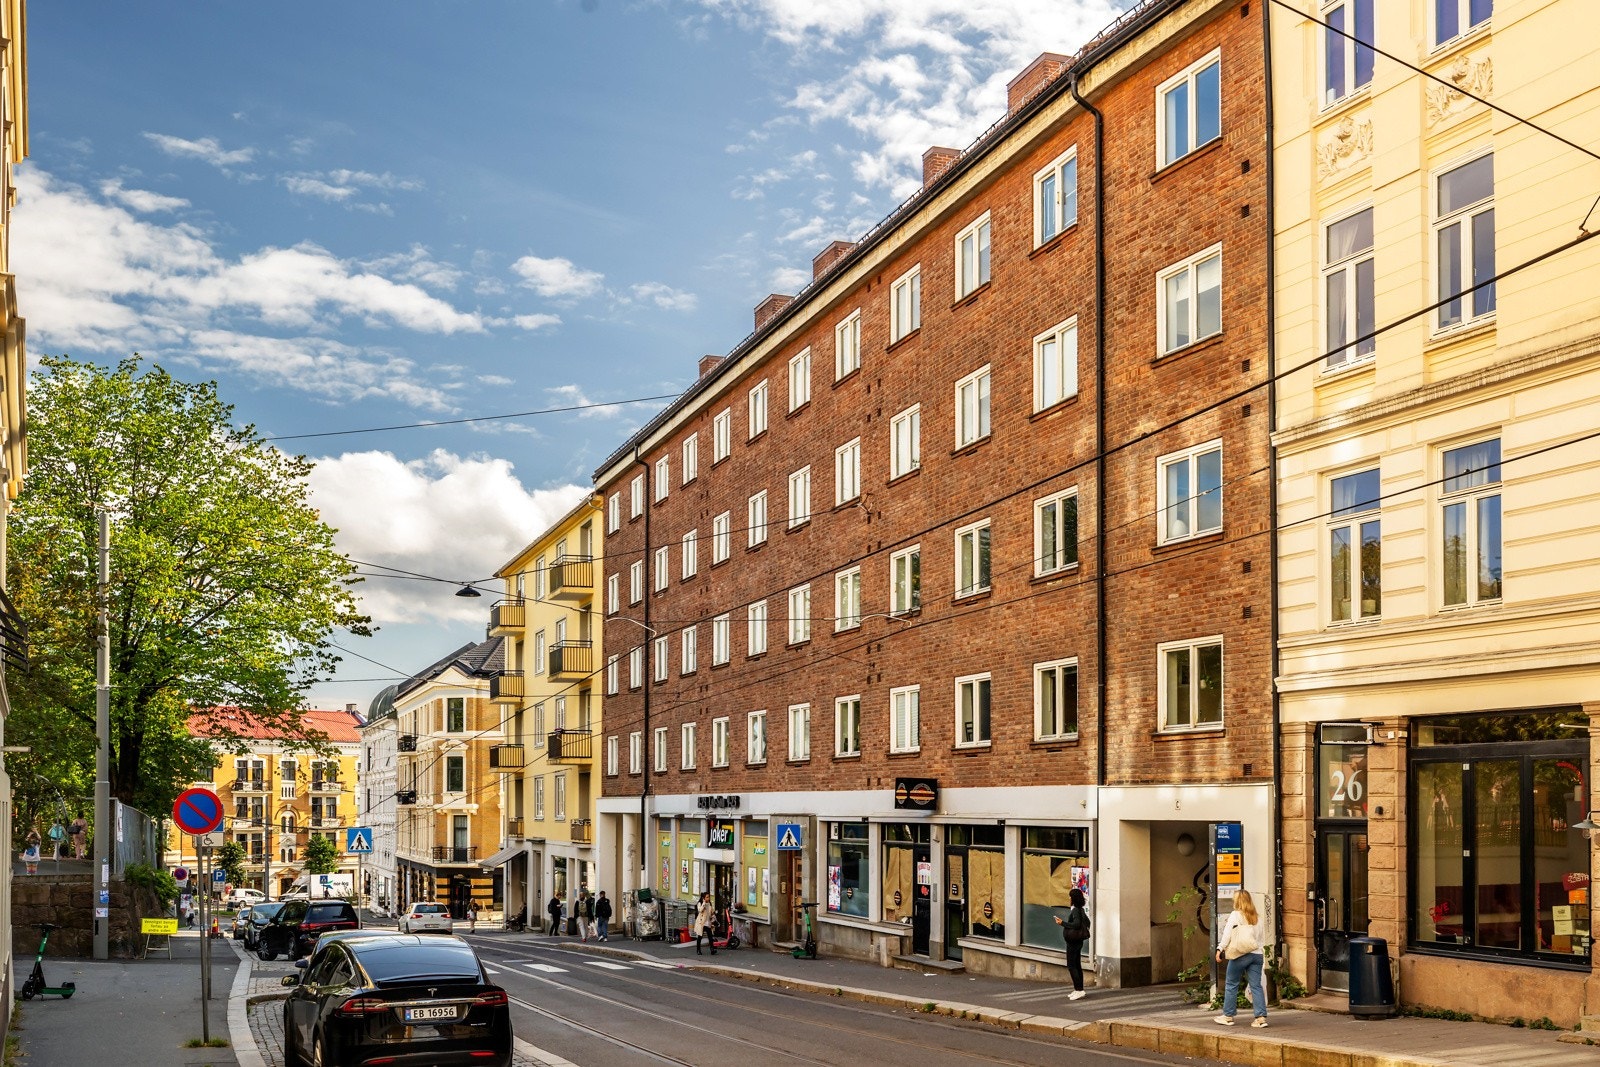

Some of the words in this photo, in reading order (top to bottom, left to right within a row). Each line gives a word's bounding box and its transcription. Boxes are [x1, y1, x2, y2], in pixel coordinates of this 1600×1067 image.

[1331, 769, 1363, 802] 26
[708, 820, 729, 847] joker
[215, 871, 223, 880] P
[413, 1009, 425, 1018] EB
[428, 1007, 454, 1017] 16956
